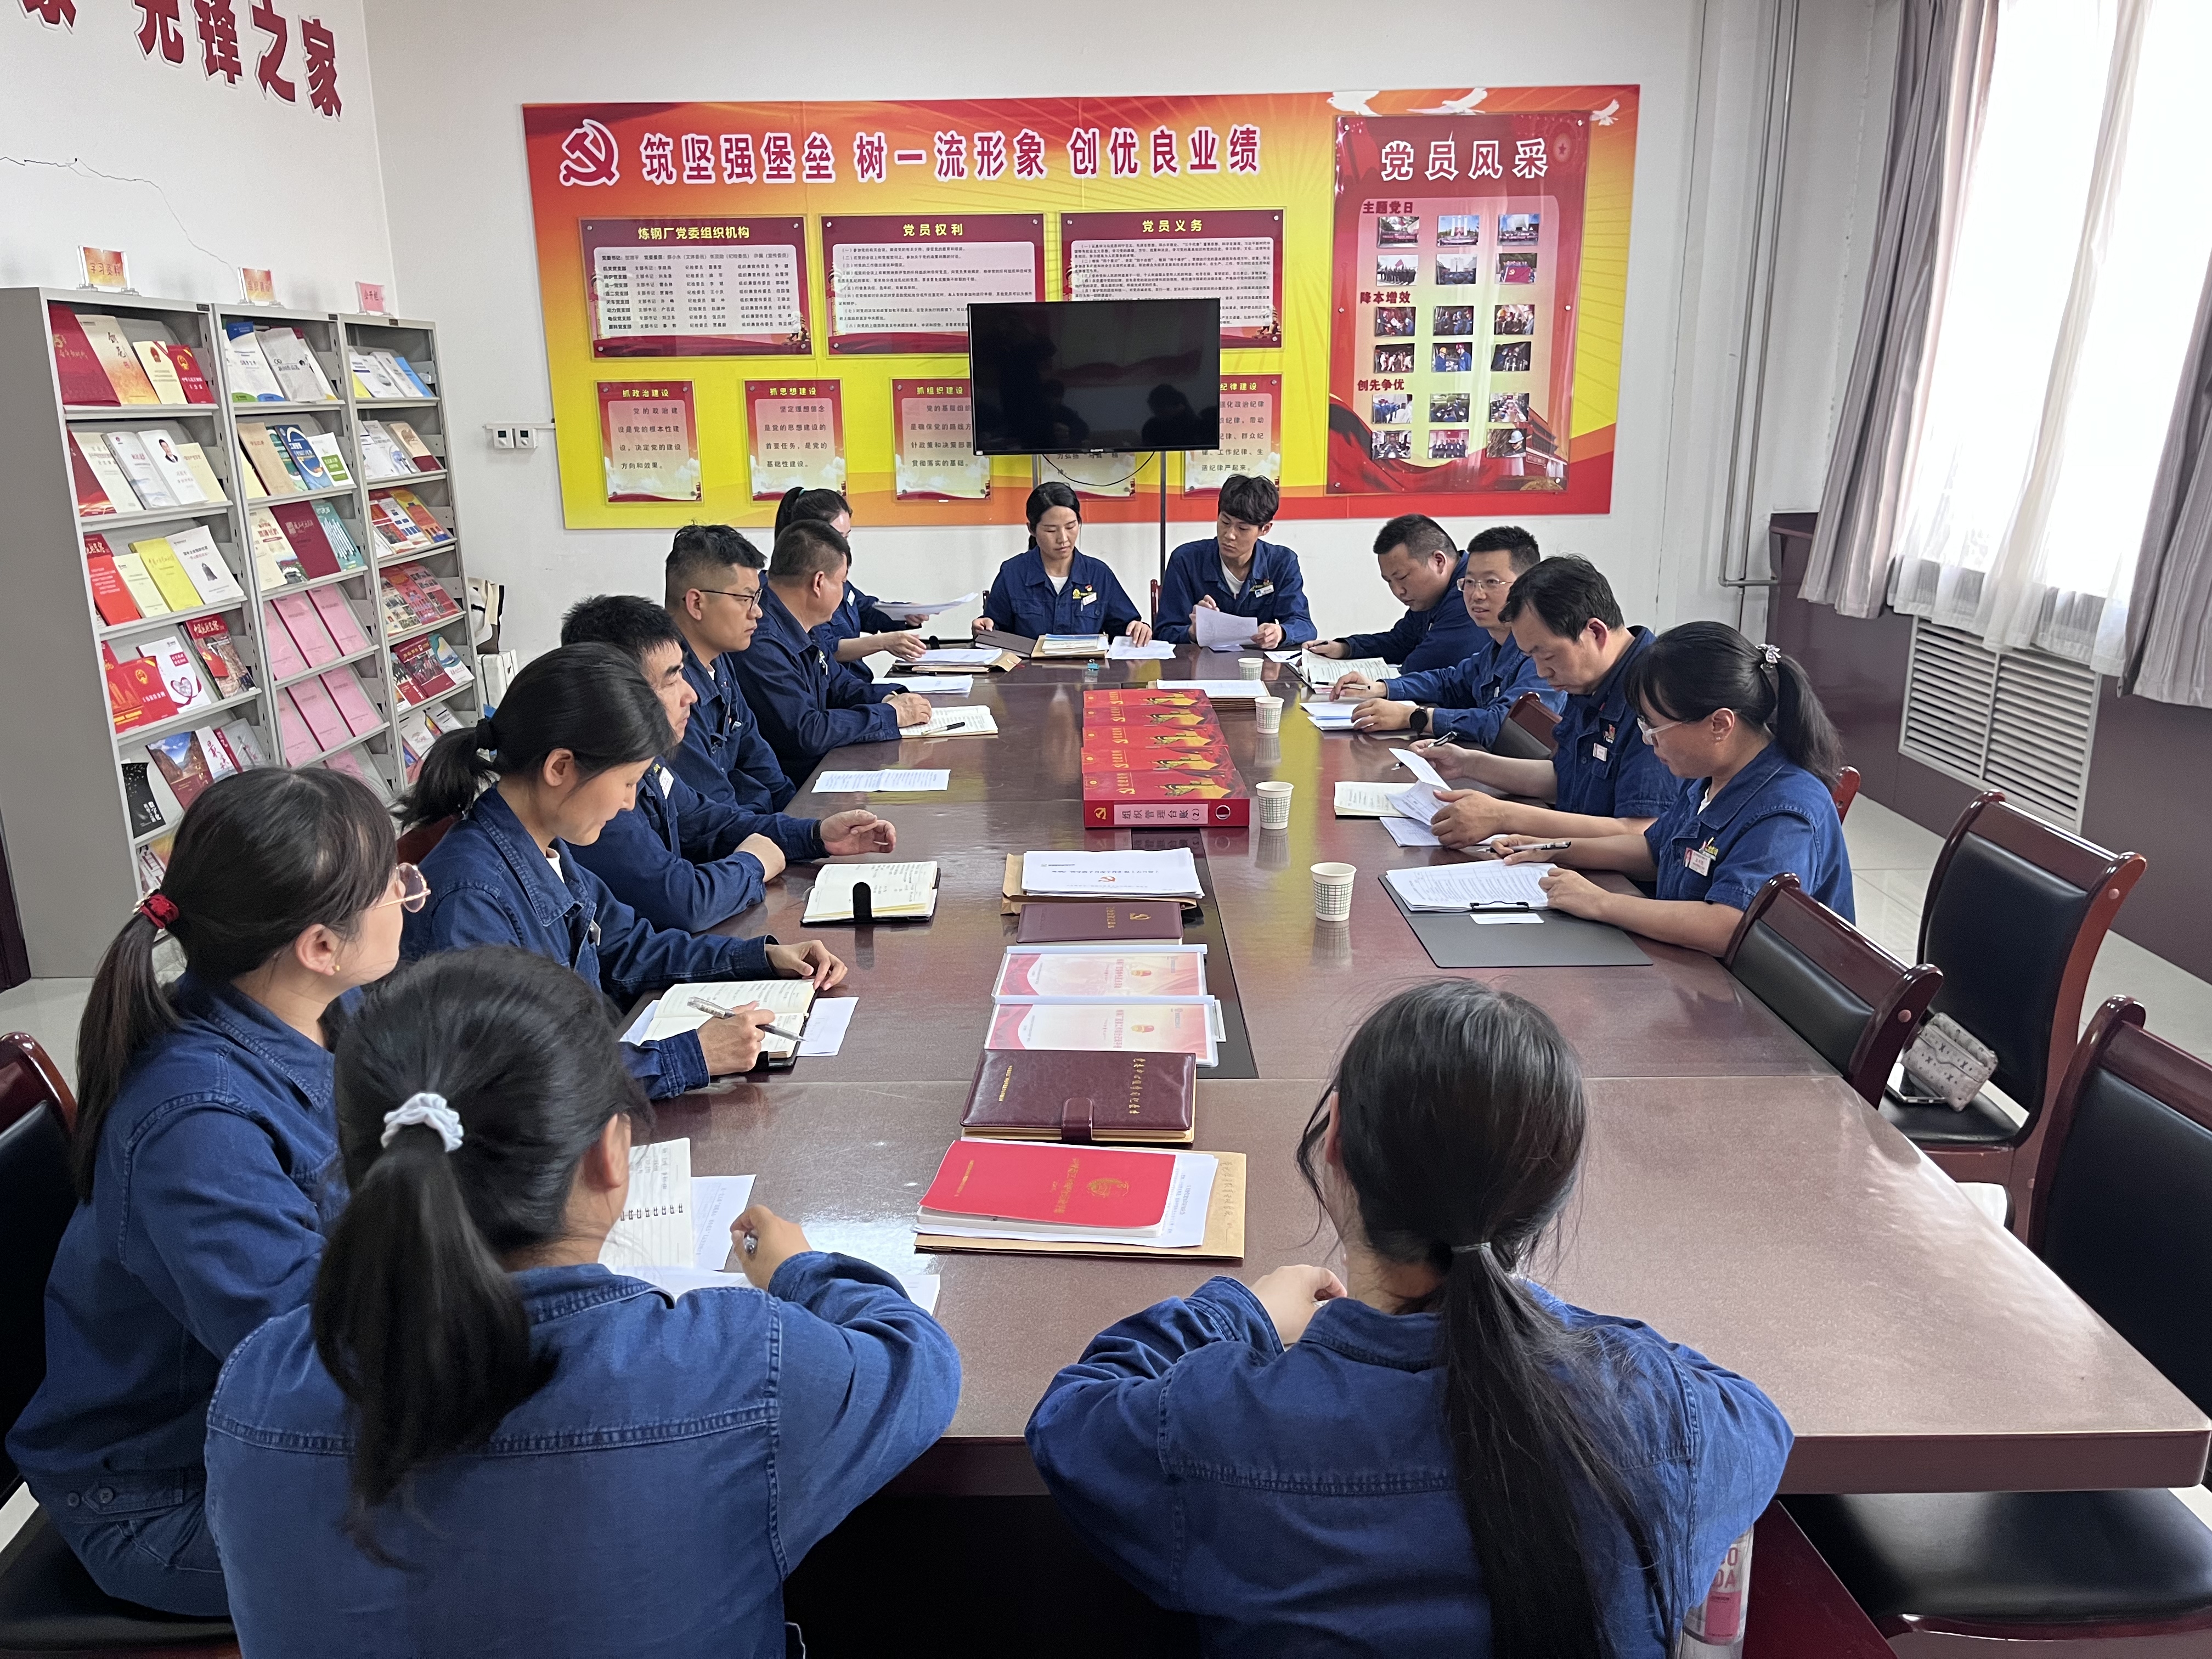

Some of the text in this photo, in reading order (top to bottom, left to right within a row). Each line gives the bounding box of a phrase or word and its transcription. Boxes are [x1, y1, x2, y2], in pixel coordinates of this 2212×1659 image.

[133, 0, 343, 121] 先锋之家
[640, 124, 1262, 185] 筑坚强堡垒 树一流形象 创优良业绩
[1381, 137, 1550, 182] 党员风采
[1362, 200, 1414, 215] 主题党日
[637, 226, 750, 240] 炼钢厂党委组织机构
[902, 223, 963, 236] 党员权利
[1142, 219, 1203, 233] 党员义务
[1359, 290, 1412, 304] 降本增效
[770, 387, 816, 396] 抓思想建设
[917, 386, 963, 395] 抓组织建设
[1357, 378, 1405, 392] 创先争优
[622, 388, 669, 398] 抓政治建设
[780, 405, 825, 413] 坚定理想信念
[618, 425, 680, 433] 设是党的根本性建
